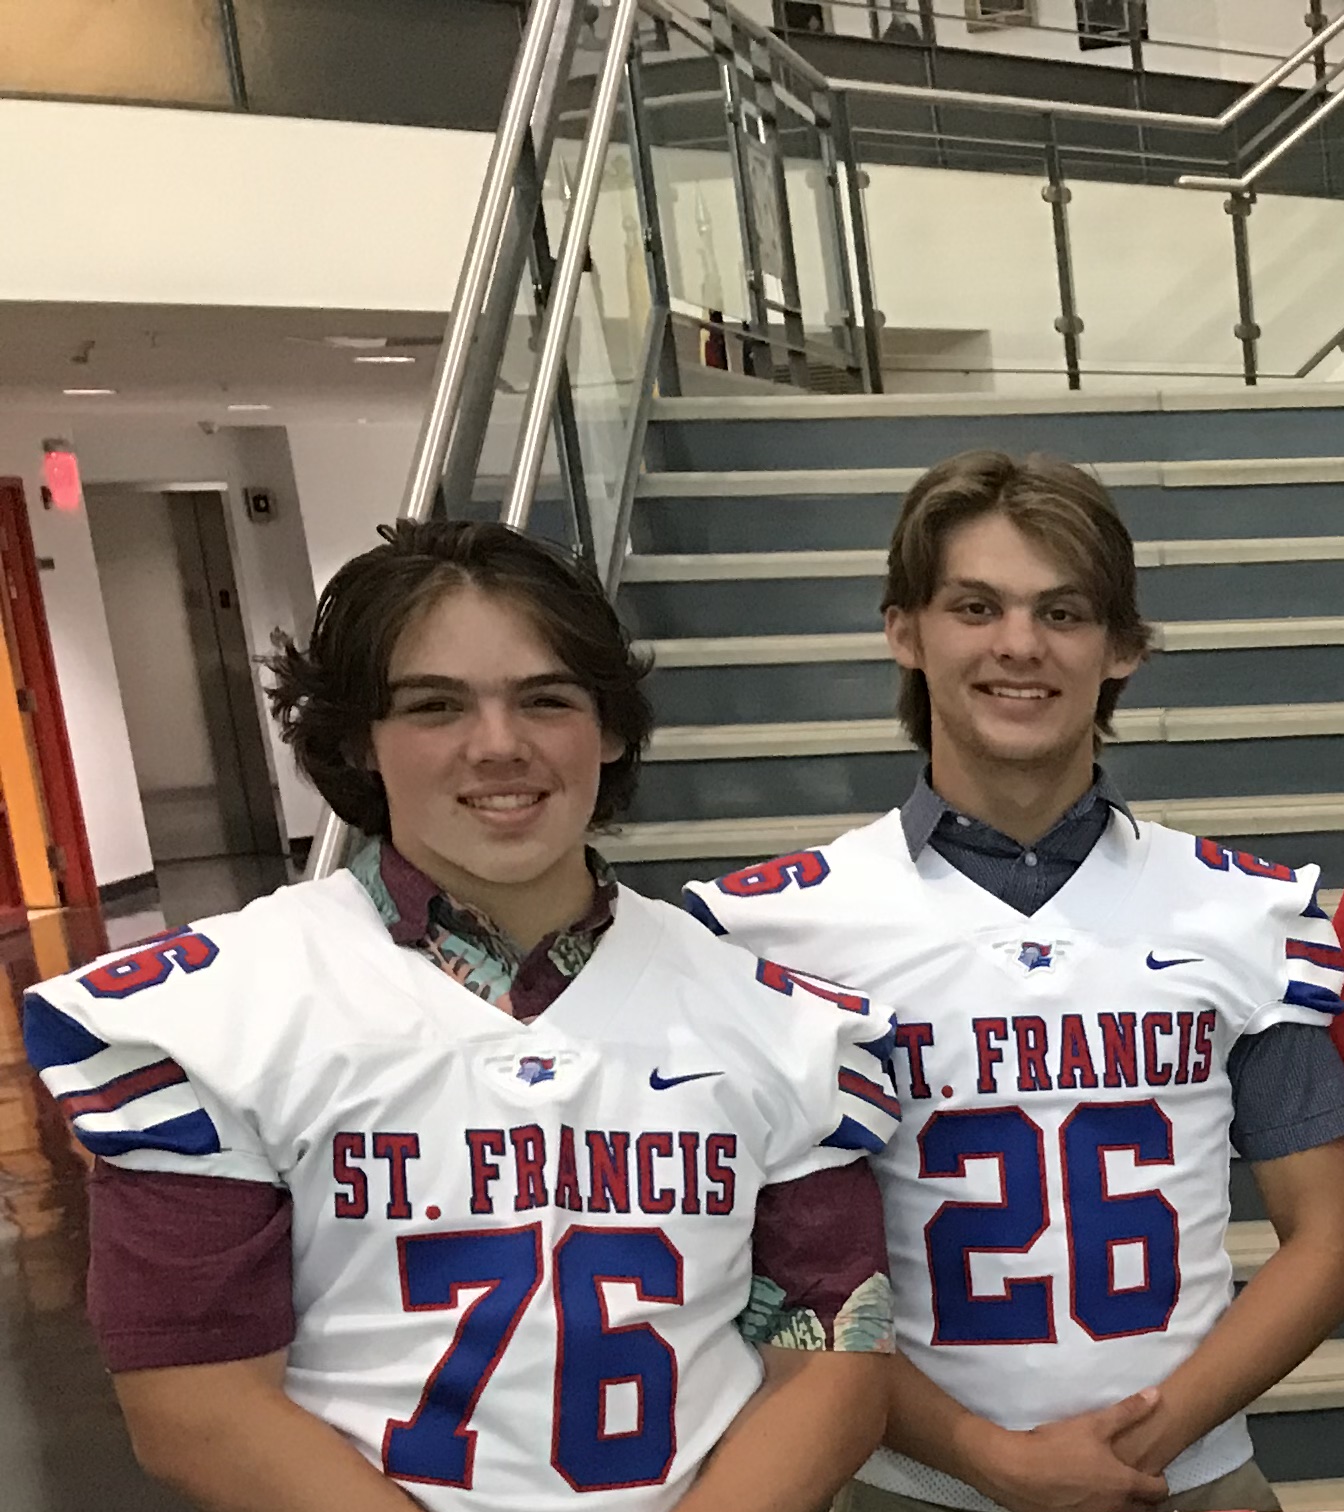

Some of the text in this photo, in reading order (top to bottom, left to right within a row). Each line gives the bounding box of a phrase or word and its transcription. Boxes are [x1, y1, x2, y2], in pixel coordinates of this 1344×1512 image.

[896, 1009, 1216, 1099] T. FRANCIS
[333, 1123, 738, 1220] ST. FRANCIS
[917, 1099, 1180, 1346] 26
[381, 1222, 684, 1494] 76
